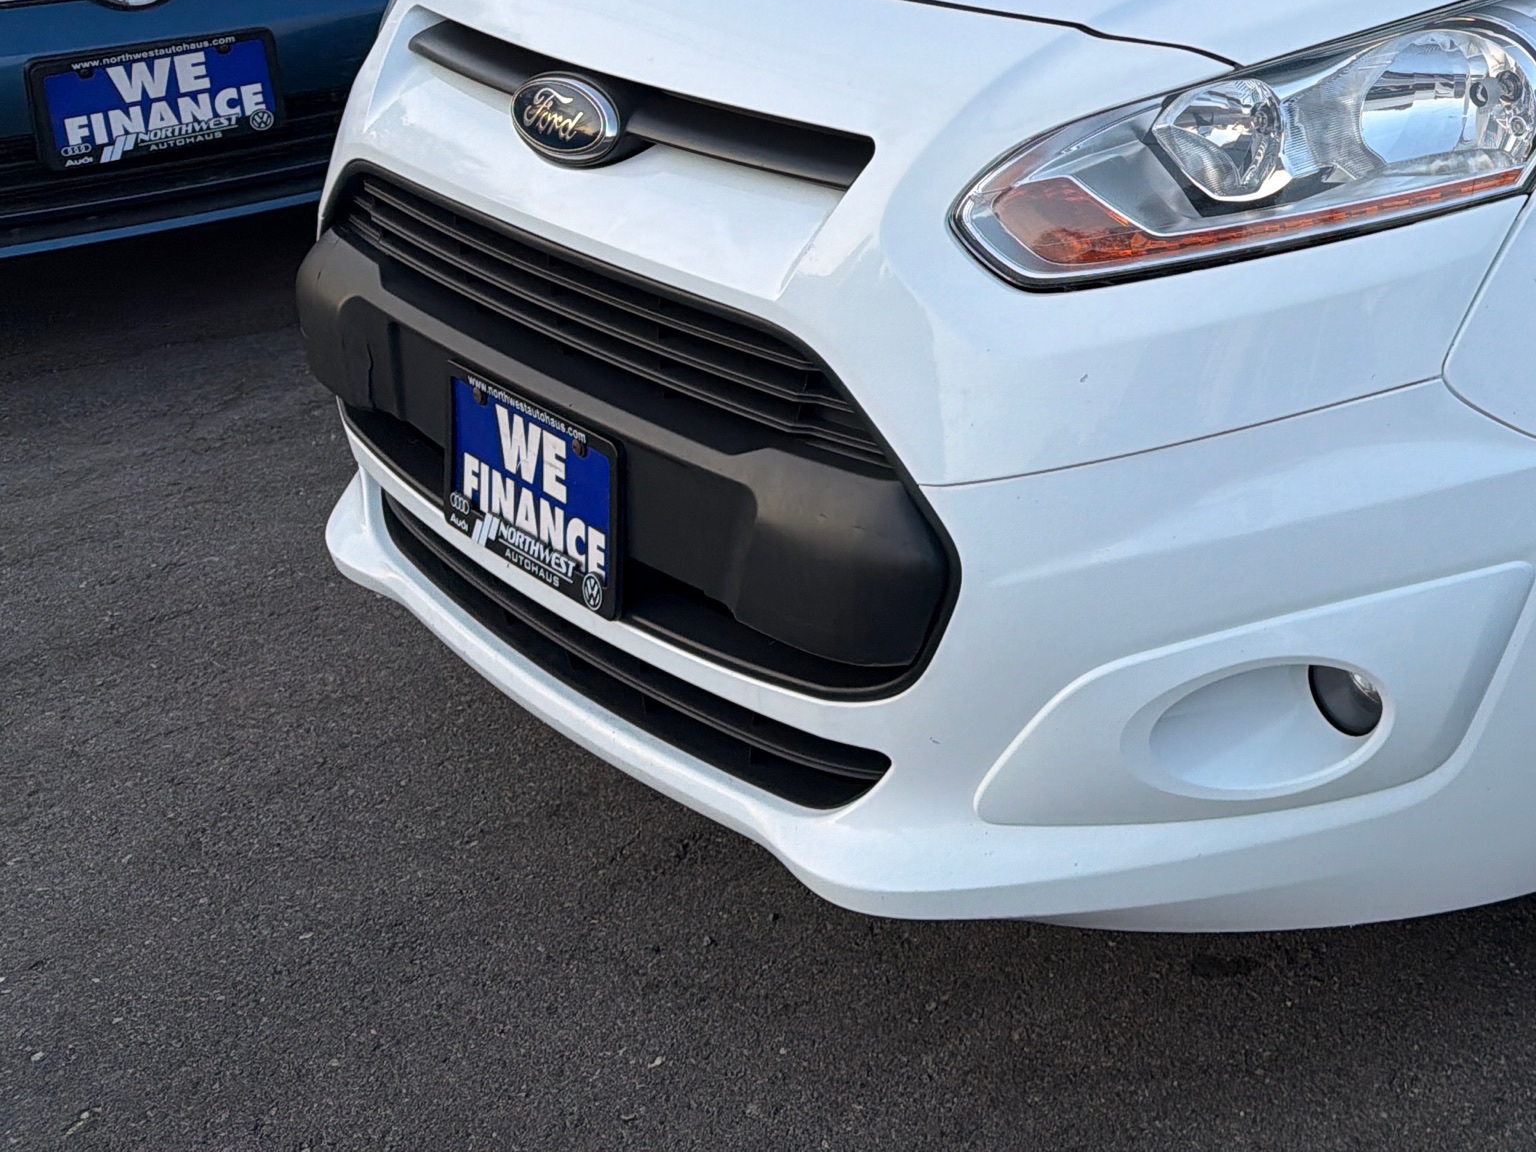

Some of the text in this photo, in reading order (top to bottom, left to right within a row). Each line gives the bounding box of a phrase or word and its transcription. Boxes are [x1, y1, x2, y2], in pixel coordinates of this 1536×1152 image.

[71, 35, 236, 71] www.northwestautohaus.com
[106, 51, 211, 104] WE
[64, 82, 267, 146] FINANCE
[137, 112, 239, 143] NORTHWEST
[150, 130, 223, 152] AUTOHAUS
[523, 87, 584, 142] Ford
[467, 374, 587, 444] www.northwestautohaus.com
[495, 403, 567, 504] WE
[463, 452, 606, 580] FINANCE
[499, 520, 576, 578] NORTHWEST
[504, 548, 560, 588] AUTOHAUS
